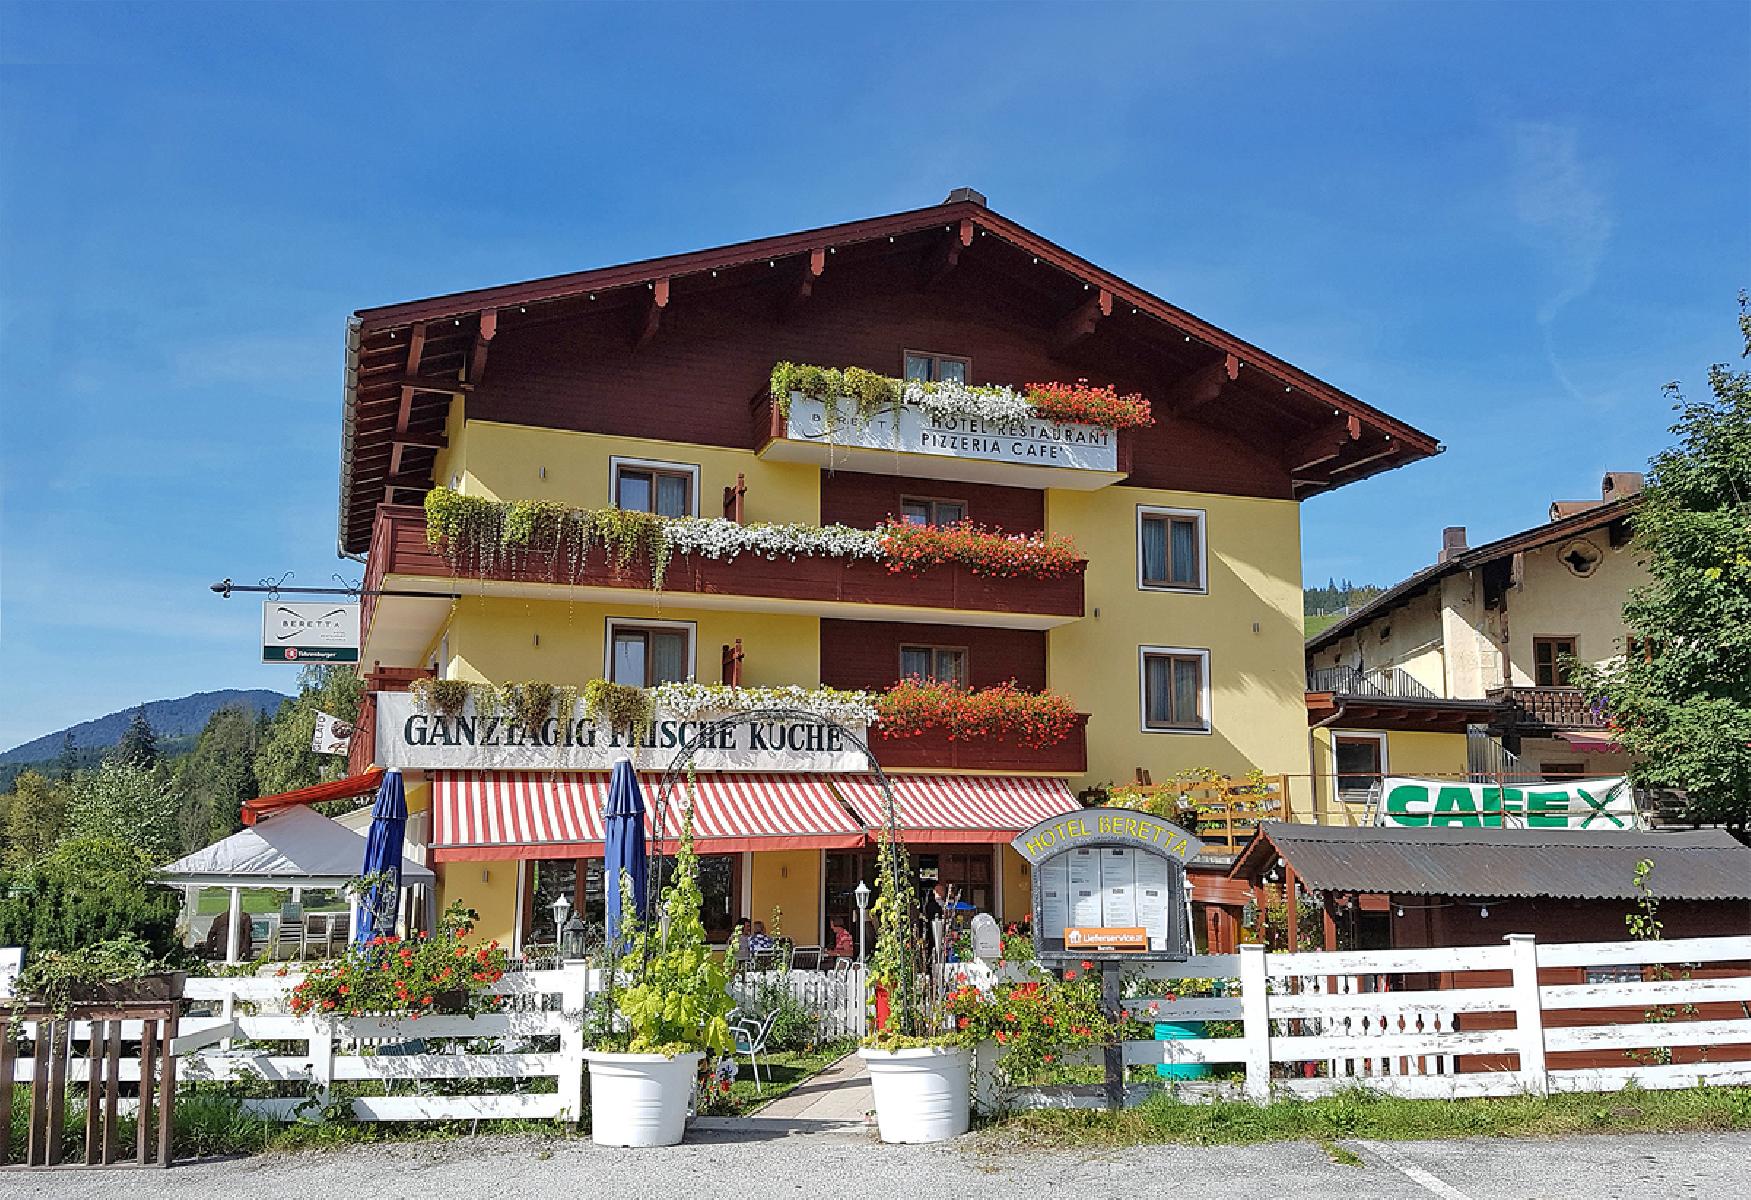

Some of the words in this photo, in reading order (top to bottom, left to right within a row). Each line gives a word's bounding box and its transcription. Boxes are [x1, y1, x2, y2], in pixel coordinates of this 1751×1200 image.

[811, 413, 900, 431] BRETTA
[931, 416, 987, 434] HOTEL
[999, 424, 1109, 446] RESTAURANT
[921, 431, 1001, 454] PIZZERIA
[282, 620, 339, 628] BERETTA
[312, 715, 326, 751] GELATO
[1387, 785, 1569, 828] CAFE
[1025, 819, 1091, 856] HOTEL
[1098, 815, 1188, 857] BERETTA
